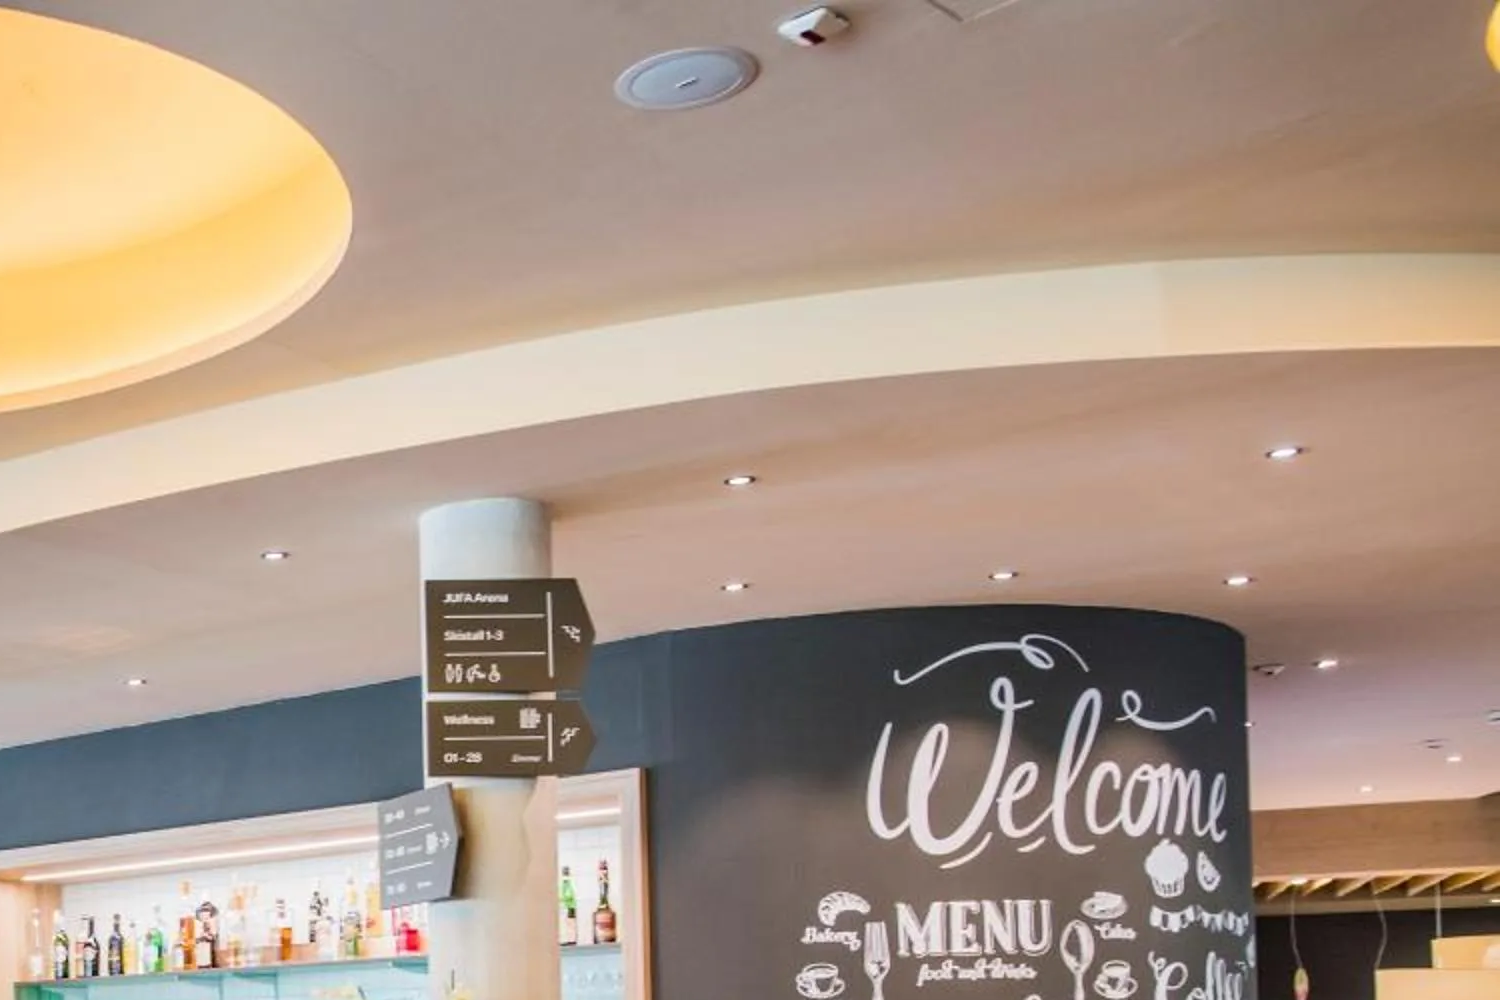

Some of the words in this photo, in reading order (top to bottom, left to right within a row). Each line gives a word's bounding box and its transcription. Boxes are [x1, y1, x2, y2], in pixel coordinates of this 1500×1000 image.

[443, 593, 473, 604] JUFA
[474, 593, 509, 603] Arena
[866, 676, 1227, 855] Welcome
[801, 927, 862, 951] Bakery
[895, 899, 1053, 958] MENU
[916, 959, 956, 987] food
